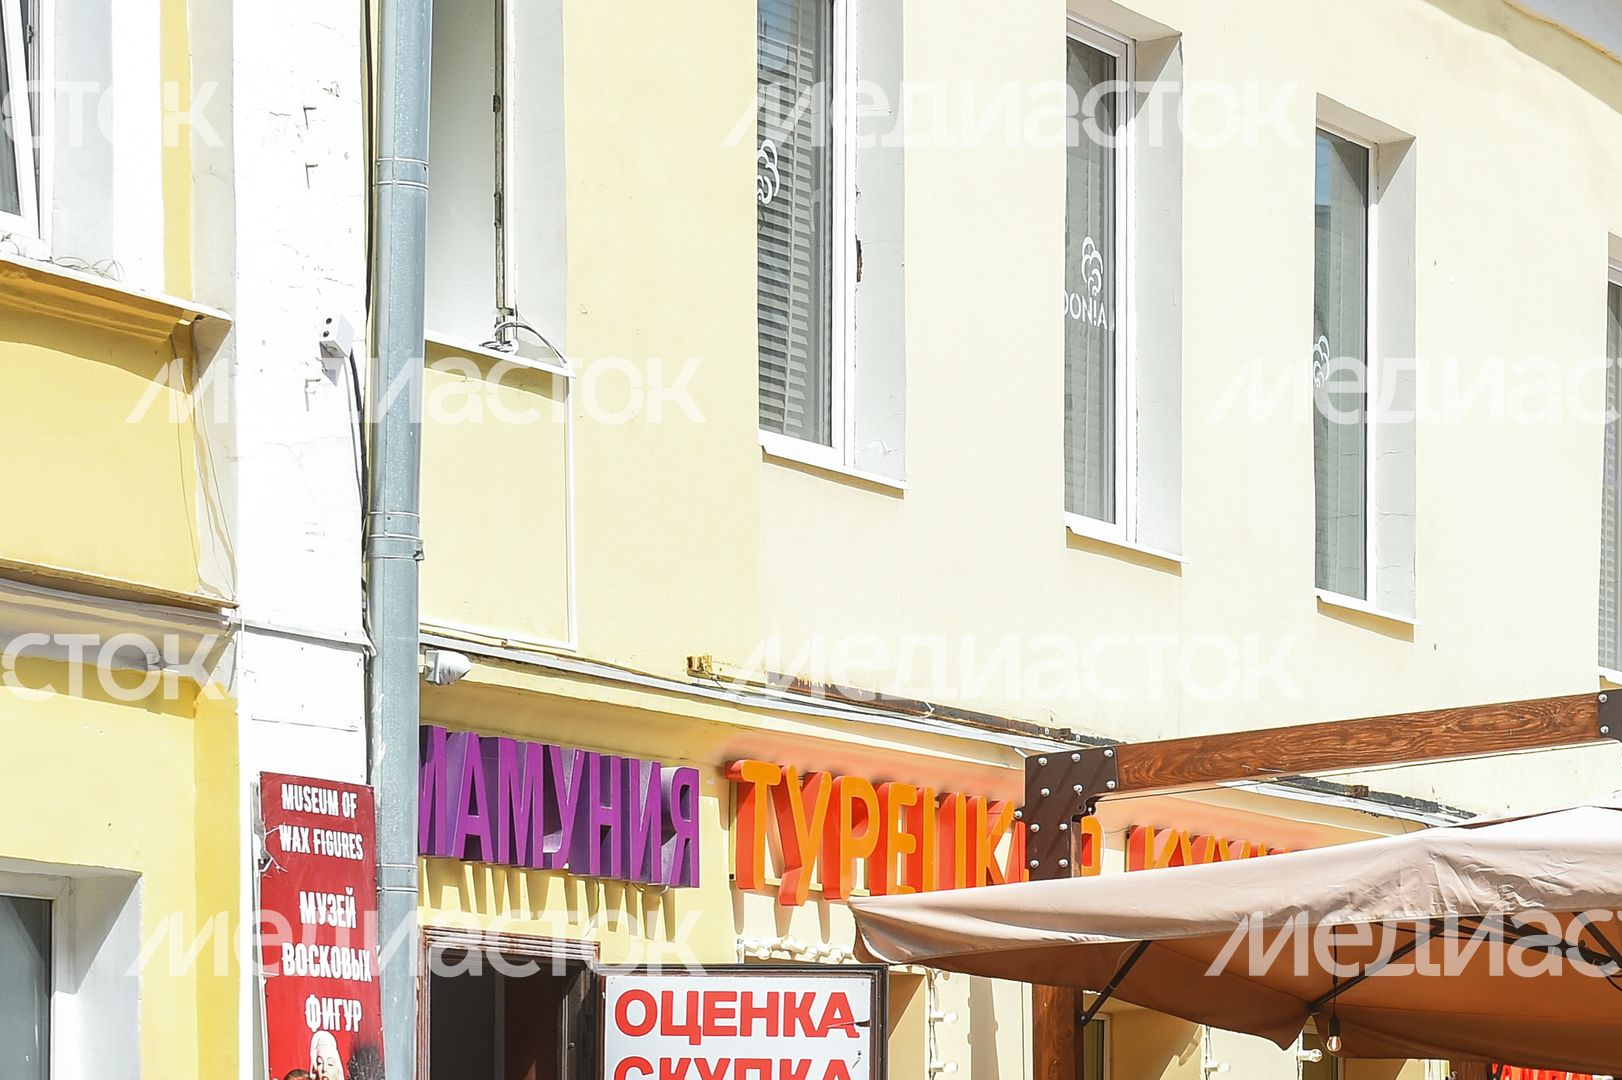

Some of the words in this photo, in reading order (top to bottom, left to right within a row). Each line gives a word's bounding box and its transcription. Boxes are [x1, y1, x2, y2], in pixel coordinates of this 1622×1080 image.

[281, 783, 339, 817] MUSEUM
[342, 791, 357, 818] OF
[279, 824, 311, 854] WAX
[313, 827, 363, 860] FIGURES
[299, 887, 356, 929] МУЗЕЙ
[281, 942, 372, 983] ВОСКОВЫХ
[305, 994, 362, 1033] ФИГУР
[614, 989, 861, 1046] ОЦЕНКА
